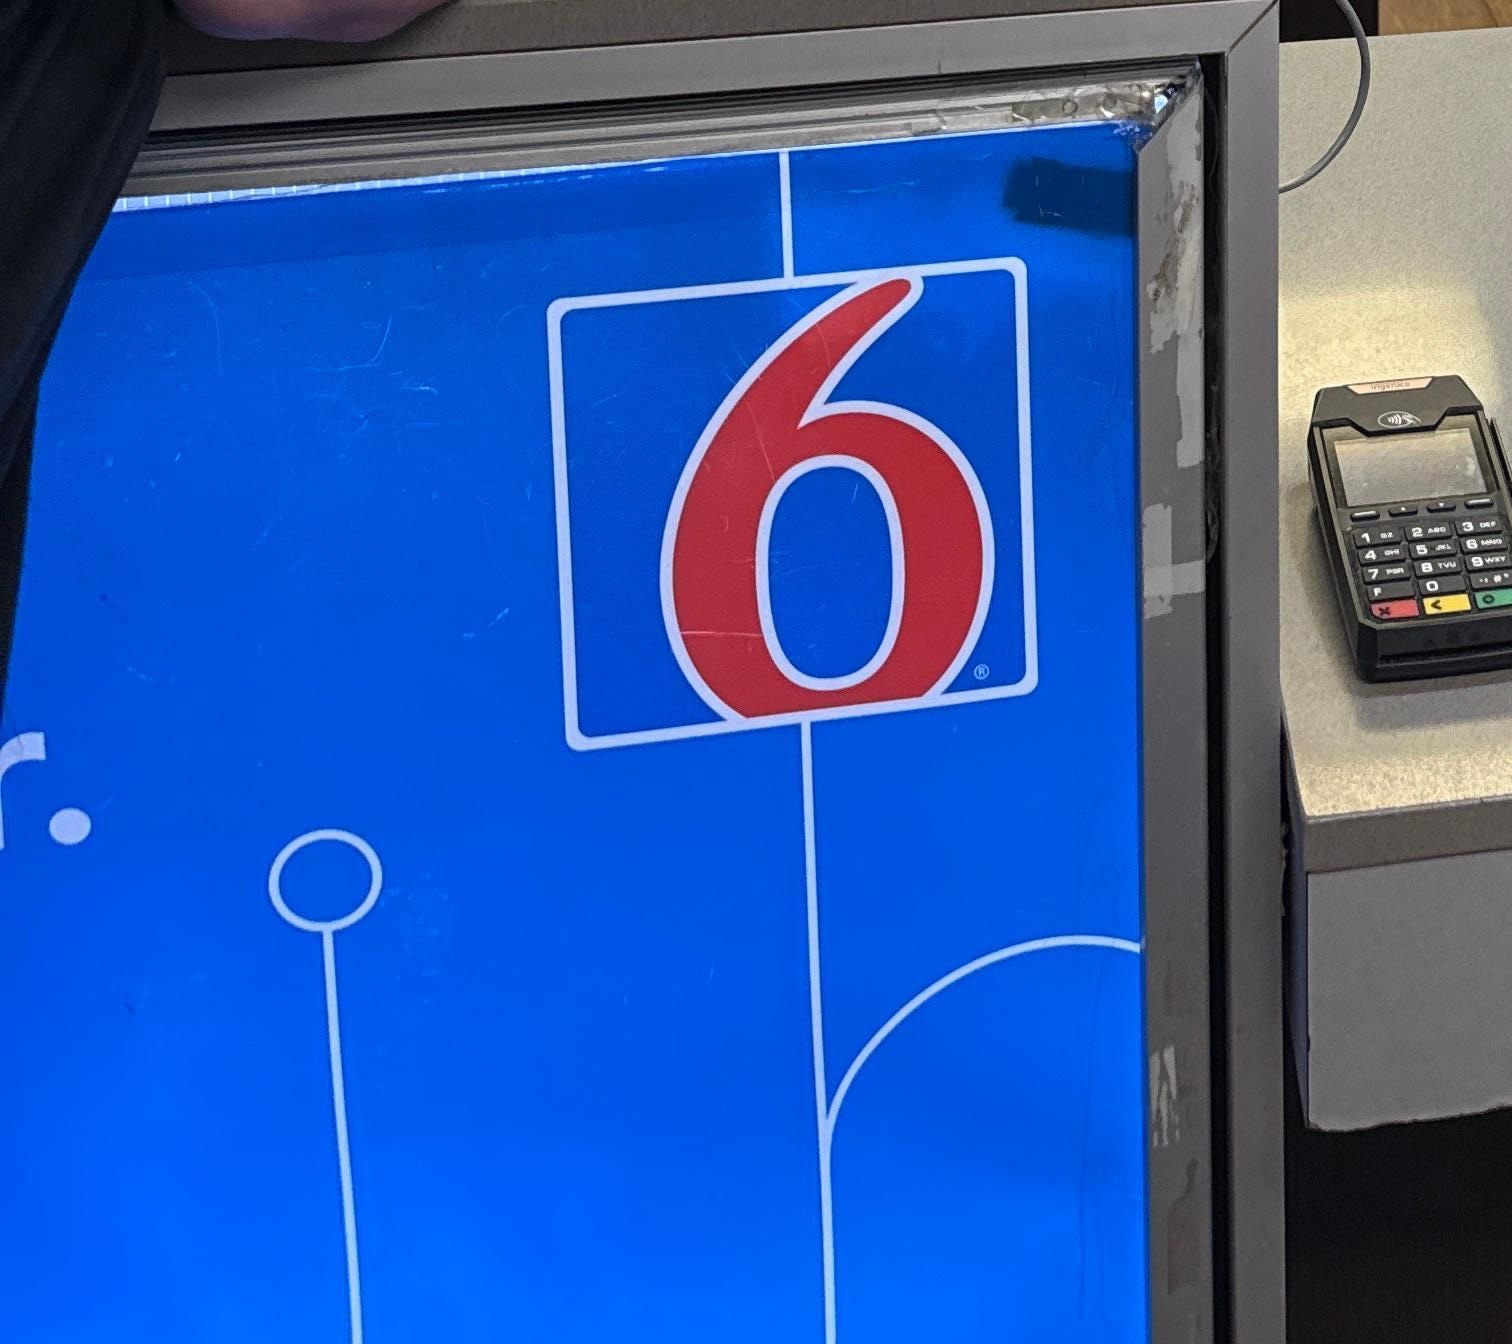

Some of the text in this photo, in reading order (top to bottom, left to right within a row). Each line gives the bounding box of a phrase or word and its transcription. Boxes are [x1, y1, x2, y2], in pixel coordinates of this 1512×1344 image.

[659, 273, 996, 723] 6
[1462, 521, 1474, 532] 3
[1361, 532, 1370, 543] 1
[1411, 527, 1423, 538] 2
[1415, 544, 1428, 555] 5
[1466, 539, 1478, 549] 6
[1364, 550, 1377, 560] 4
[1471, 556, 1484, 567] 9
[1421, 562, 1433, 573] 8
[1368, 568, 1379, 580] 7
